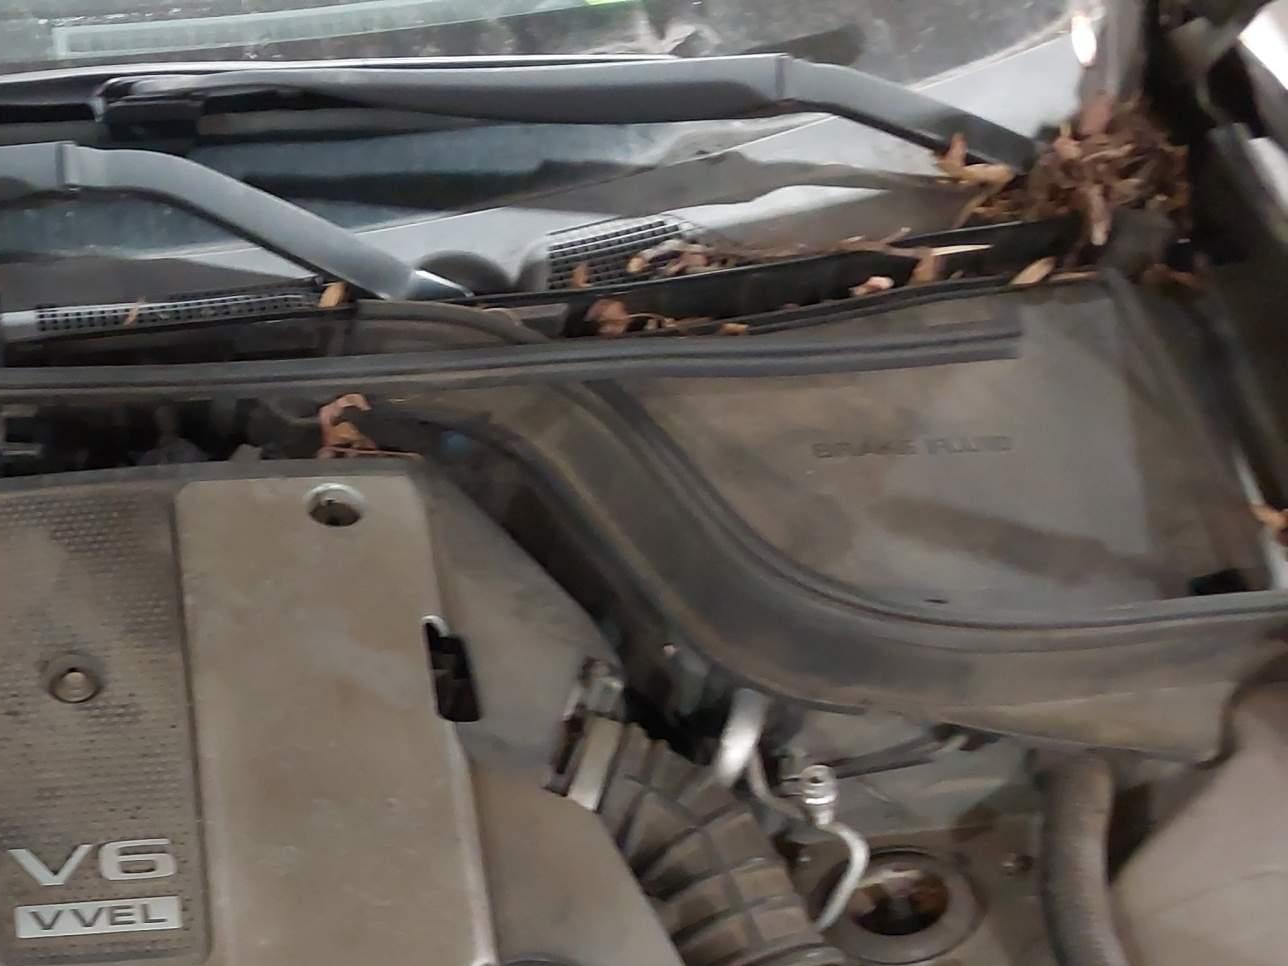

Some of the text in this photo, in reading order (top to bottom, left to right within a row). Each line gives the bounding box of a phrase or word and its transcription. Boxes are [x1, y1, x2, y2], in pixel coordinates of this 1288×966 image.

[812, 435, 1015, 459] BRAKE FLUID
[8, 838, 177, 886] V6
[29, 903, 169, 931] VVEL
